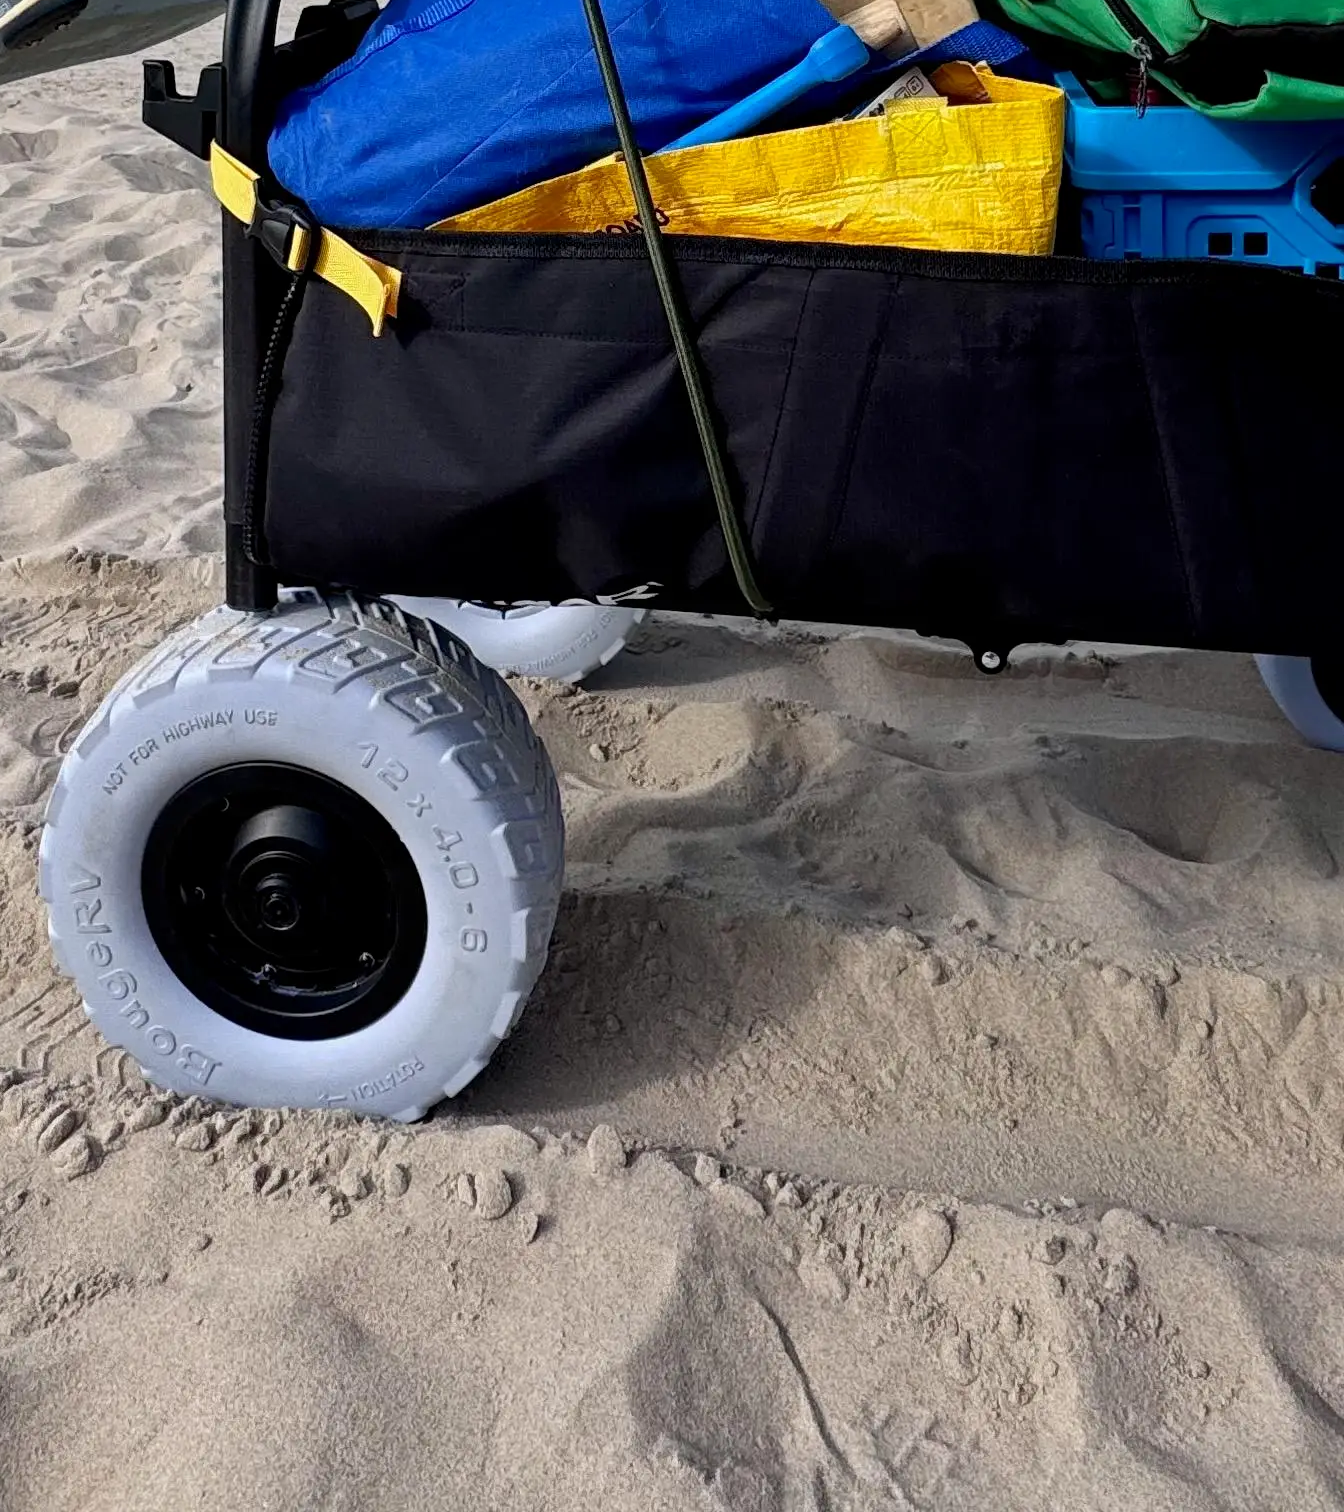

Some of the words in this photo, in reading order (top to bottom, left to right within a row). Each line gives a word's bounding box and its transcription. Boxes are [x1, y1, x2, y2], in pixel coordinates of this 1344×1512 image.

[102, 762, 129, 795] NOT
[128, 737, 160, 766] FOR
[162, 709, 235, 744] HIGHWAY
[244, 708, 278, 727] USE
[356, 741, 409, 792] 12
[68, 862, 223, 1086] BougeRV
